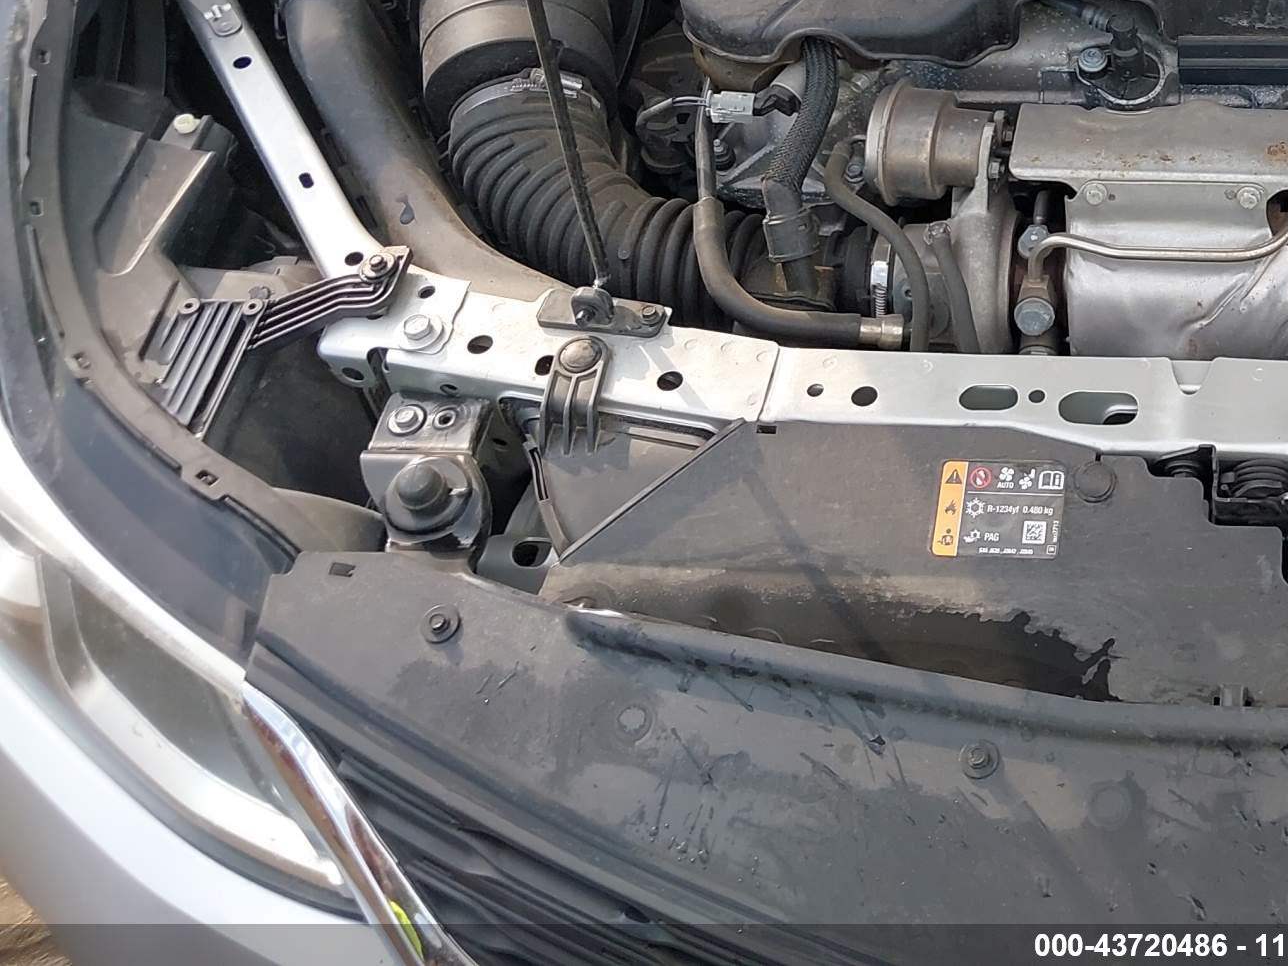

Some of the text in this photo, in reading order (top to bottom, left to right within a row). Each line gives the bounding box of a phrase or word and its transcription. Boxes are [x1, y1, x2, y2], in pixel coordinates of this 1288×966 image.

[996, 481, 1014, 489] AUTO
[1044, 506, 1054, 516] kg
[983, 532, 1000, 542] PAG
